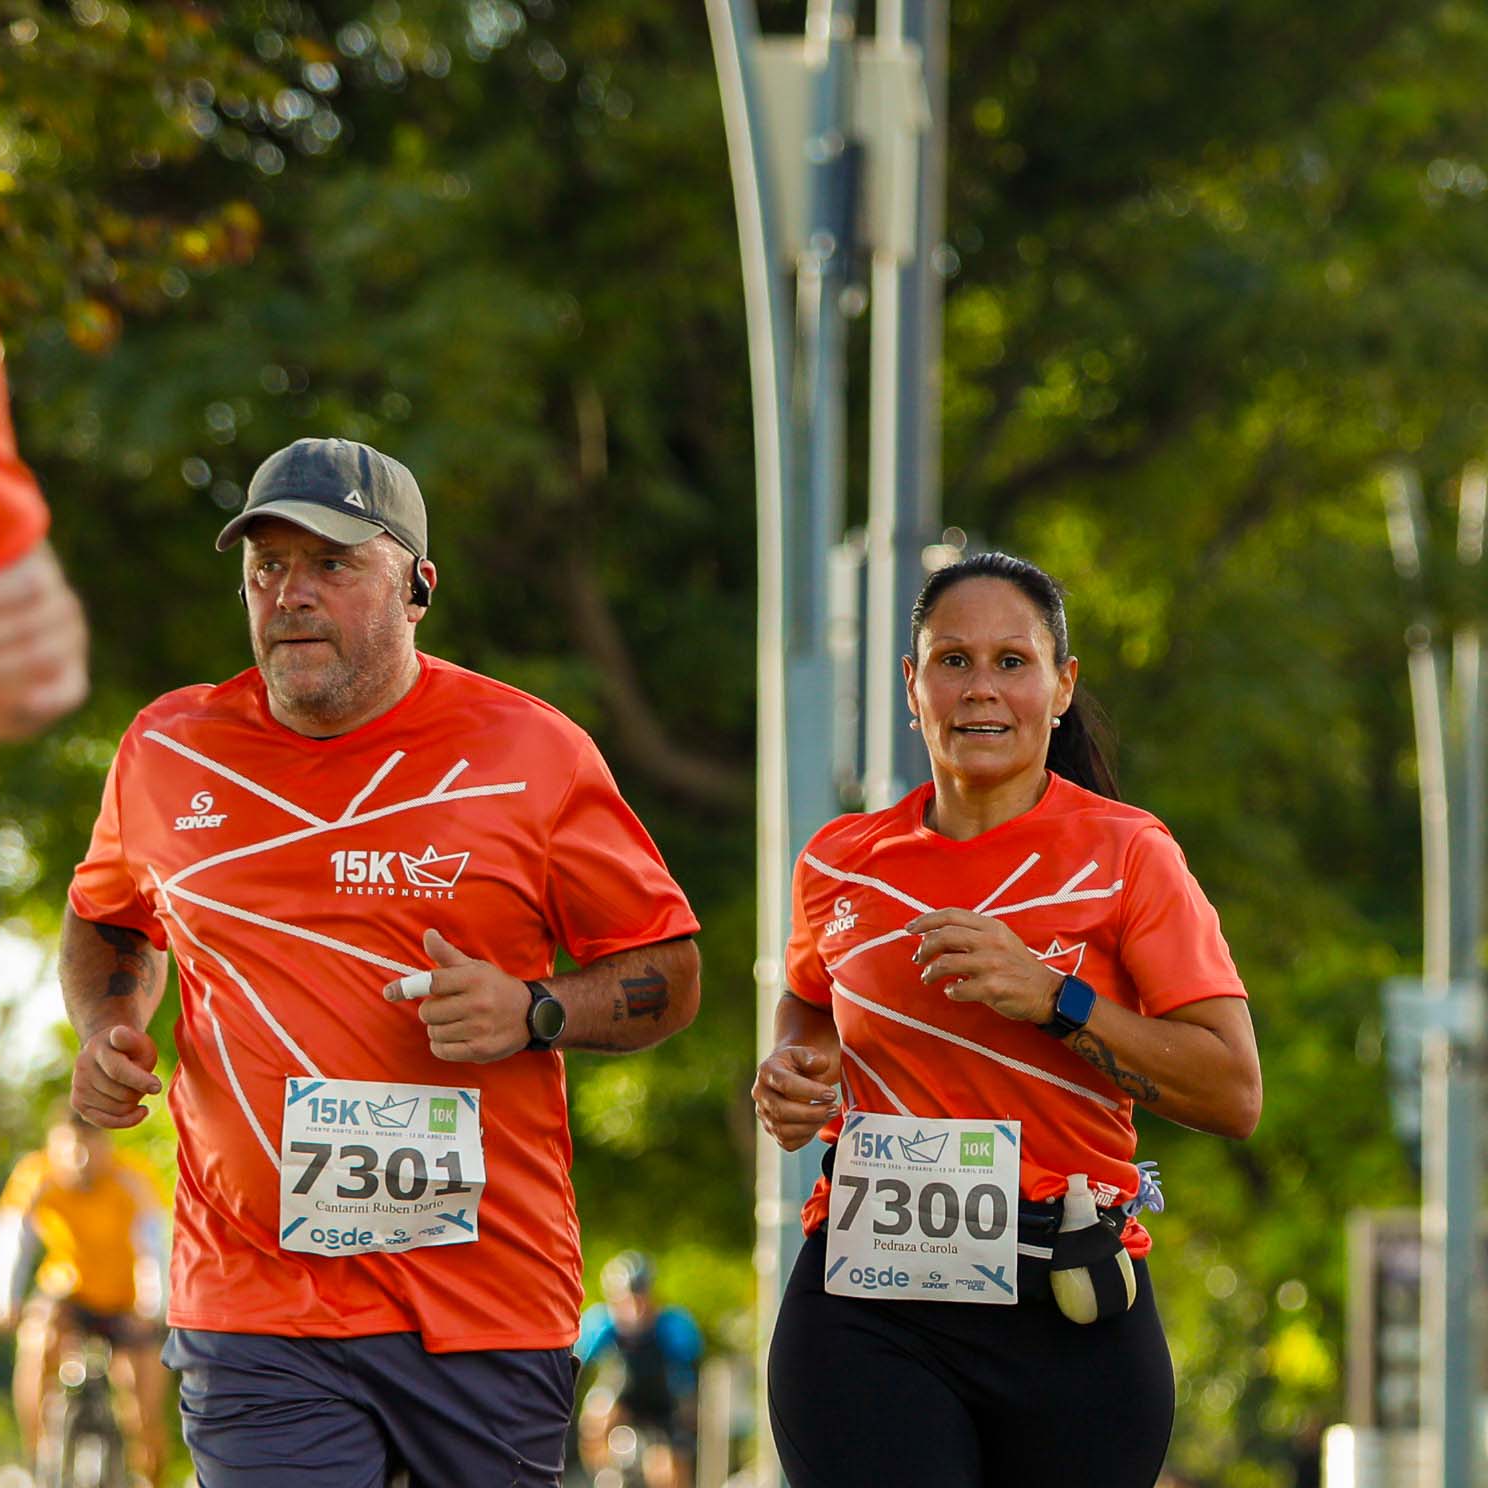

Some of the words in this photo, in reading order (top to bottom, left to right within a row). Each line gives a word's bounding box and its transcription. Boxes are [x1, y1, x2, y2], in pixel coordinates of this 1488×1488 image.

[331, 851, 397, 884] 15K
[335, 886, 395, 896] PUERTO
[401, 889, 455, 900] NORTE
[307, 1097, 361, 1126] 15K
[432, 1107, 455, 1123] 10K
[851, 1131, 894, 1160] 15K
[964, 1143, 991, 1157] 10K
[290, 1141, 472, 1201] 7301
[315, 1200, 369, 1214] Cantarini
[373, 1201, 410, 1214] Ruben
[414, 1200, 444, 1214] Dario
[836, 1174, 1008, 1241] 7300
[311, 1226, 373, 1247] osde
[873, 1239, 917, 1253] Pedraza
[920, 1242, 958, 1255] Carola
[849, 1265, 910, 1288] osde
